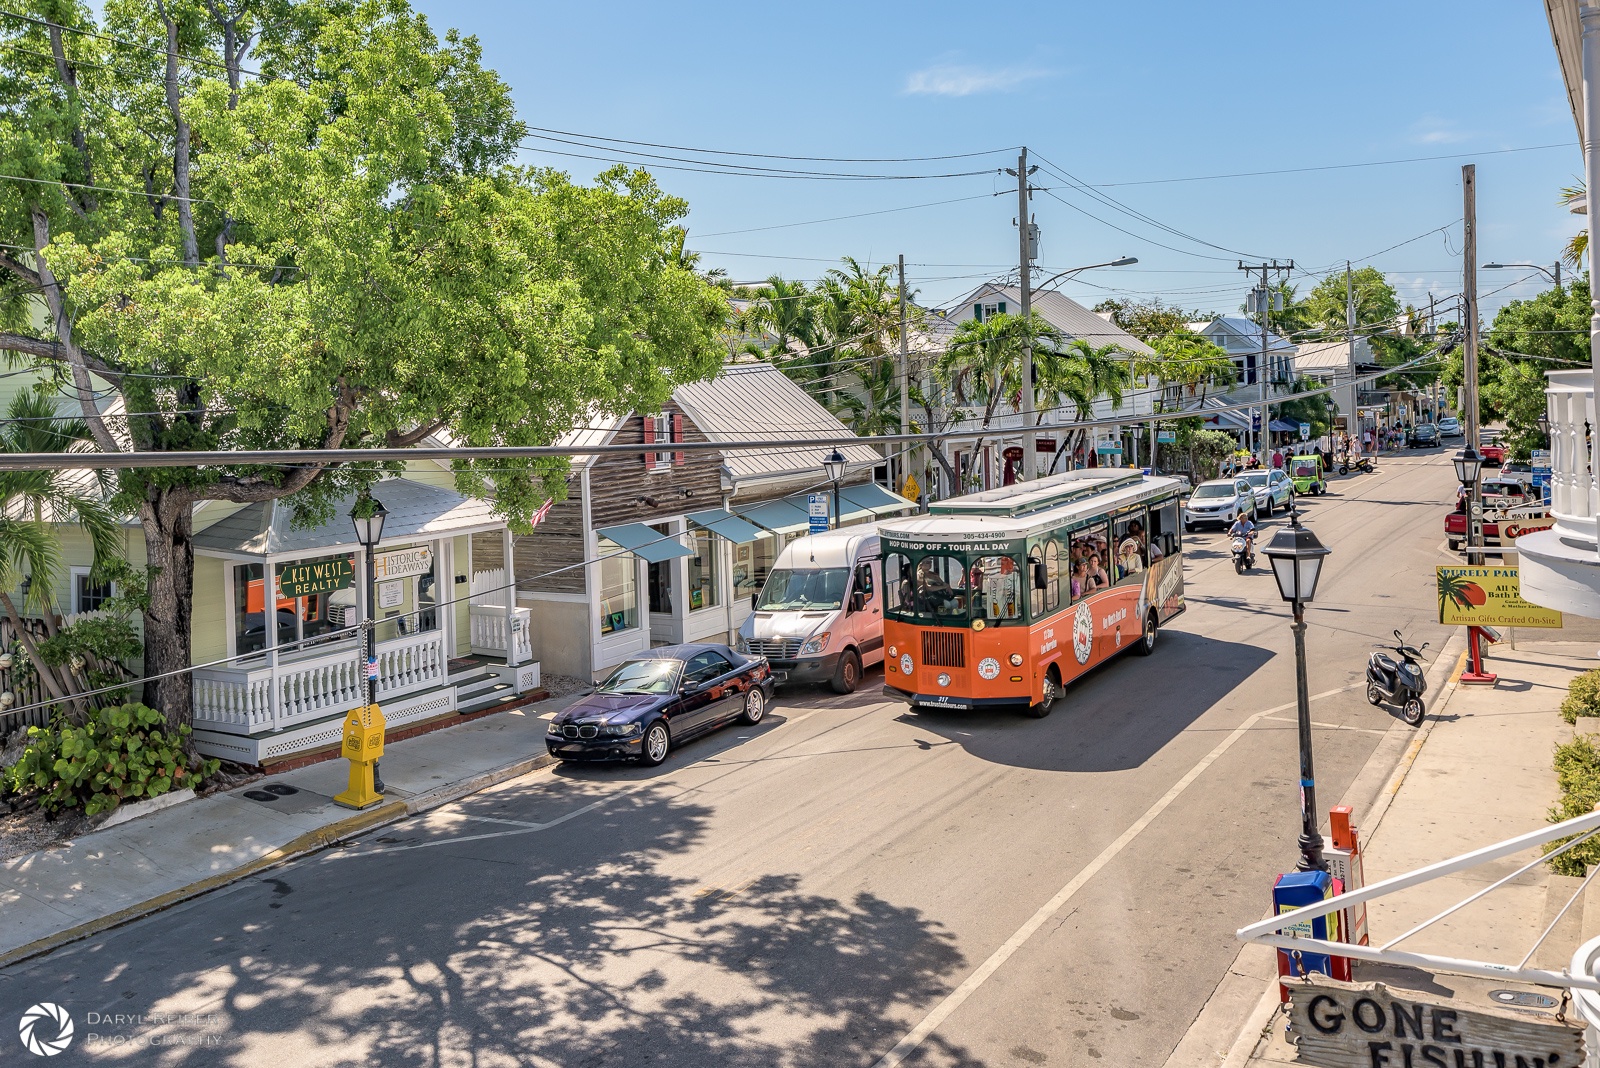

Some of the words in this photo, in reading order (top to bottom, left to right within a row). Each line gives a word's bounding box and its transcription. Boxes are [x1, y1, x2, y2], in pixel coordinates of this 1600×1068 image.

[907, 491, 915, 499] END
[1494, 511, 1509, 520] ONE
[1511, 512, 1527, 520] WAY
[889, 540, 900, 548] HOP
[900, 541, 909, 549] ON
[909, 541, 923, 550] HOP
[926, 543, 942, 551] OFF
[948, 543, 972, 552] TOUR
[973, 543, 990, 551] ALL
[374, 551, 420, 577] HISTORIC
[292, 566, 310, 583] KEY
[313, 561, 342, 580] WEST
[1442, 569, 1490, 578] PURELY
[1493, 569, 1519, 578] PAR
[295, 578, 340, 595] REALTY
[1495, 584, 1508, 592] All
[1488, 591, 1510, 599] Bath
[1450, 614, 1476, 622] Artisan
[1478, 614, 1496, 623] Gifts
[1498, 615, 1525, 624] Crafted
[1527, 616, 1556, 625] On-Site
[1307, 994, 1462, 1044] GONE
